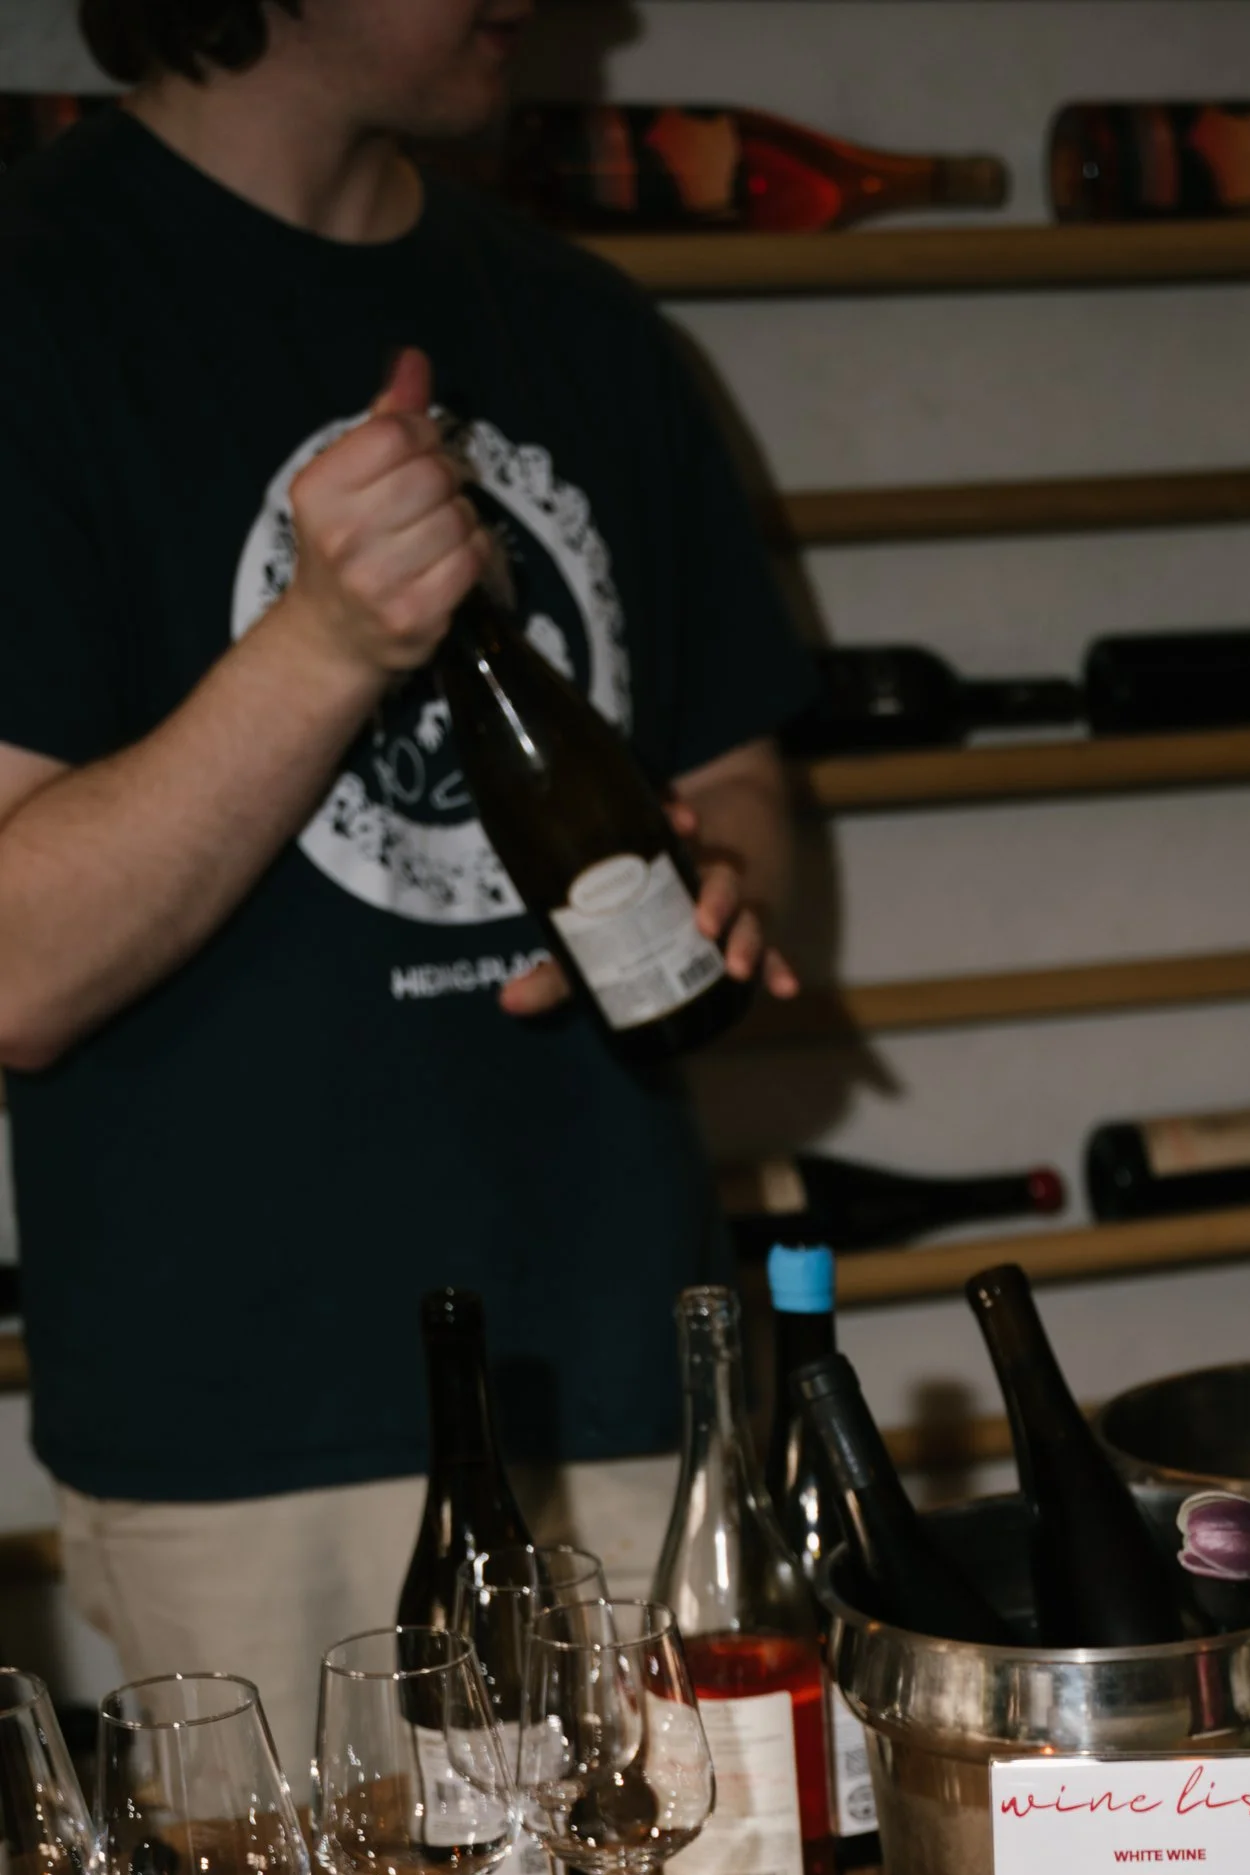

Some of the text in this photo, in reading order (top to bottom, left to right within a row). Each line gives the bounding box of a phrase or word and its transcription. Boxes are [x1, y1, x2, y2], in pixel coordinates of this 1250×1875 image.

[1001, 1785, 1162, 1818] wine
[1114, 1849, 1206, 1862] WHITE WINE
